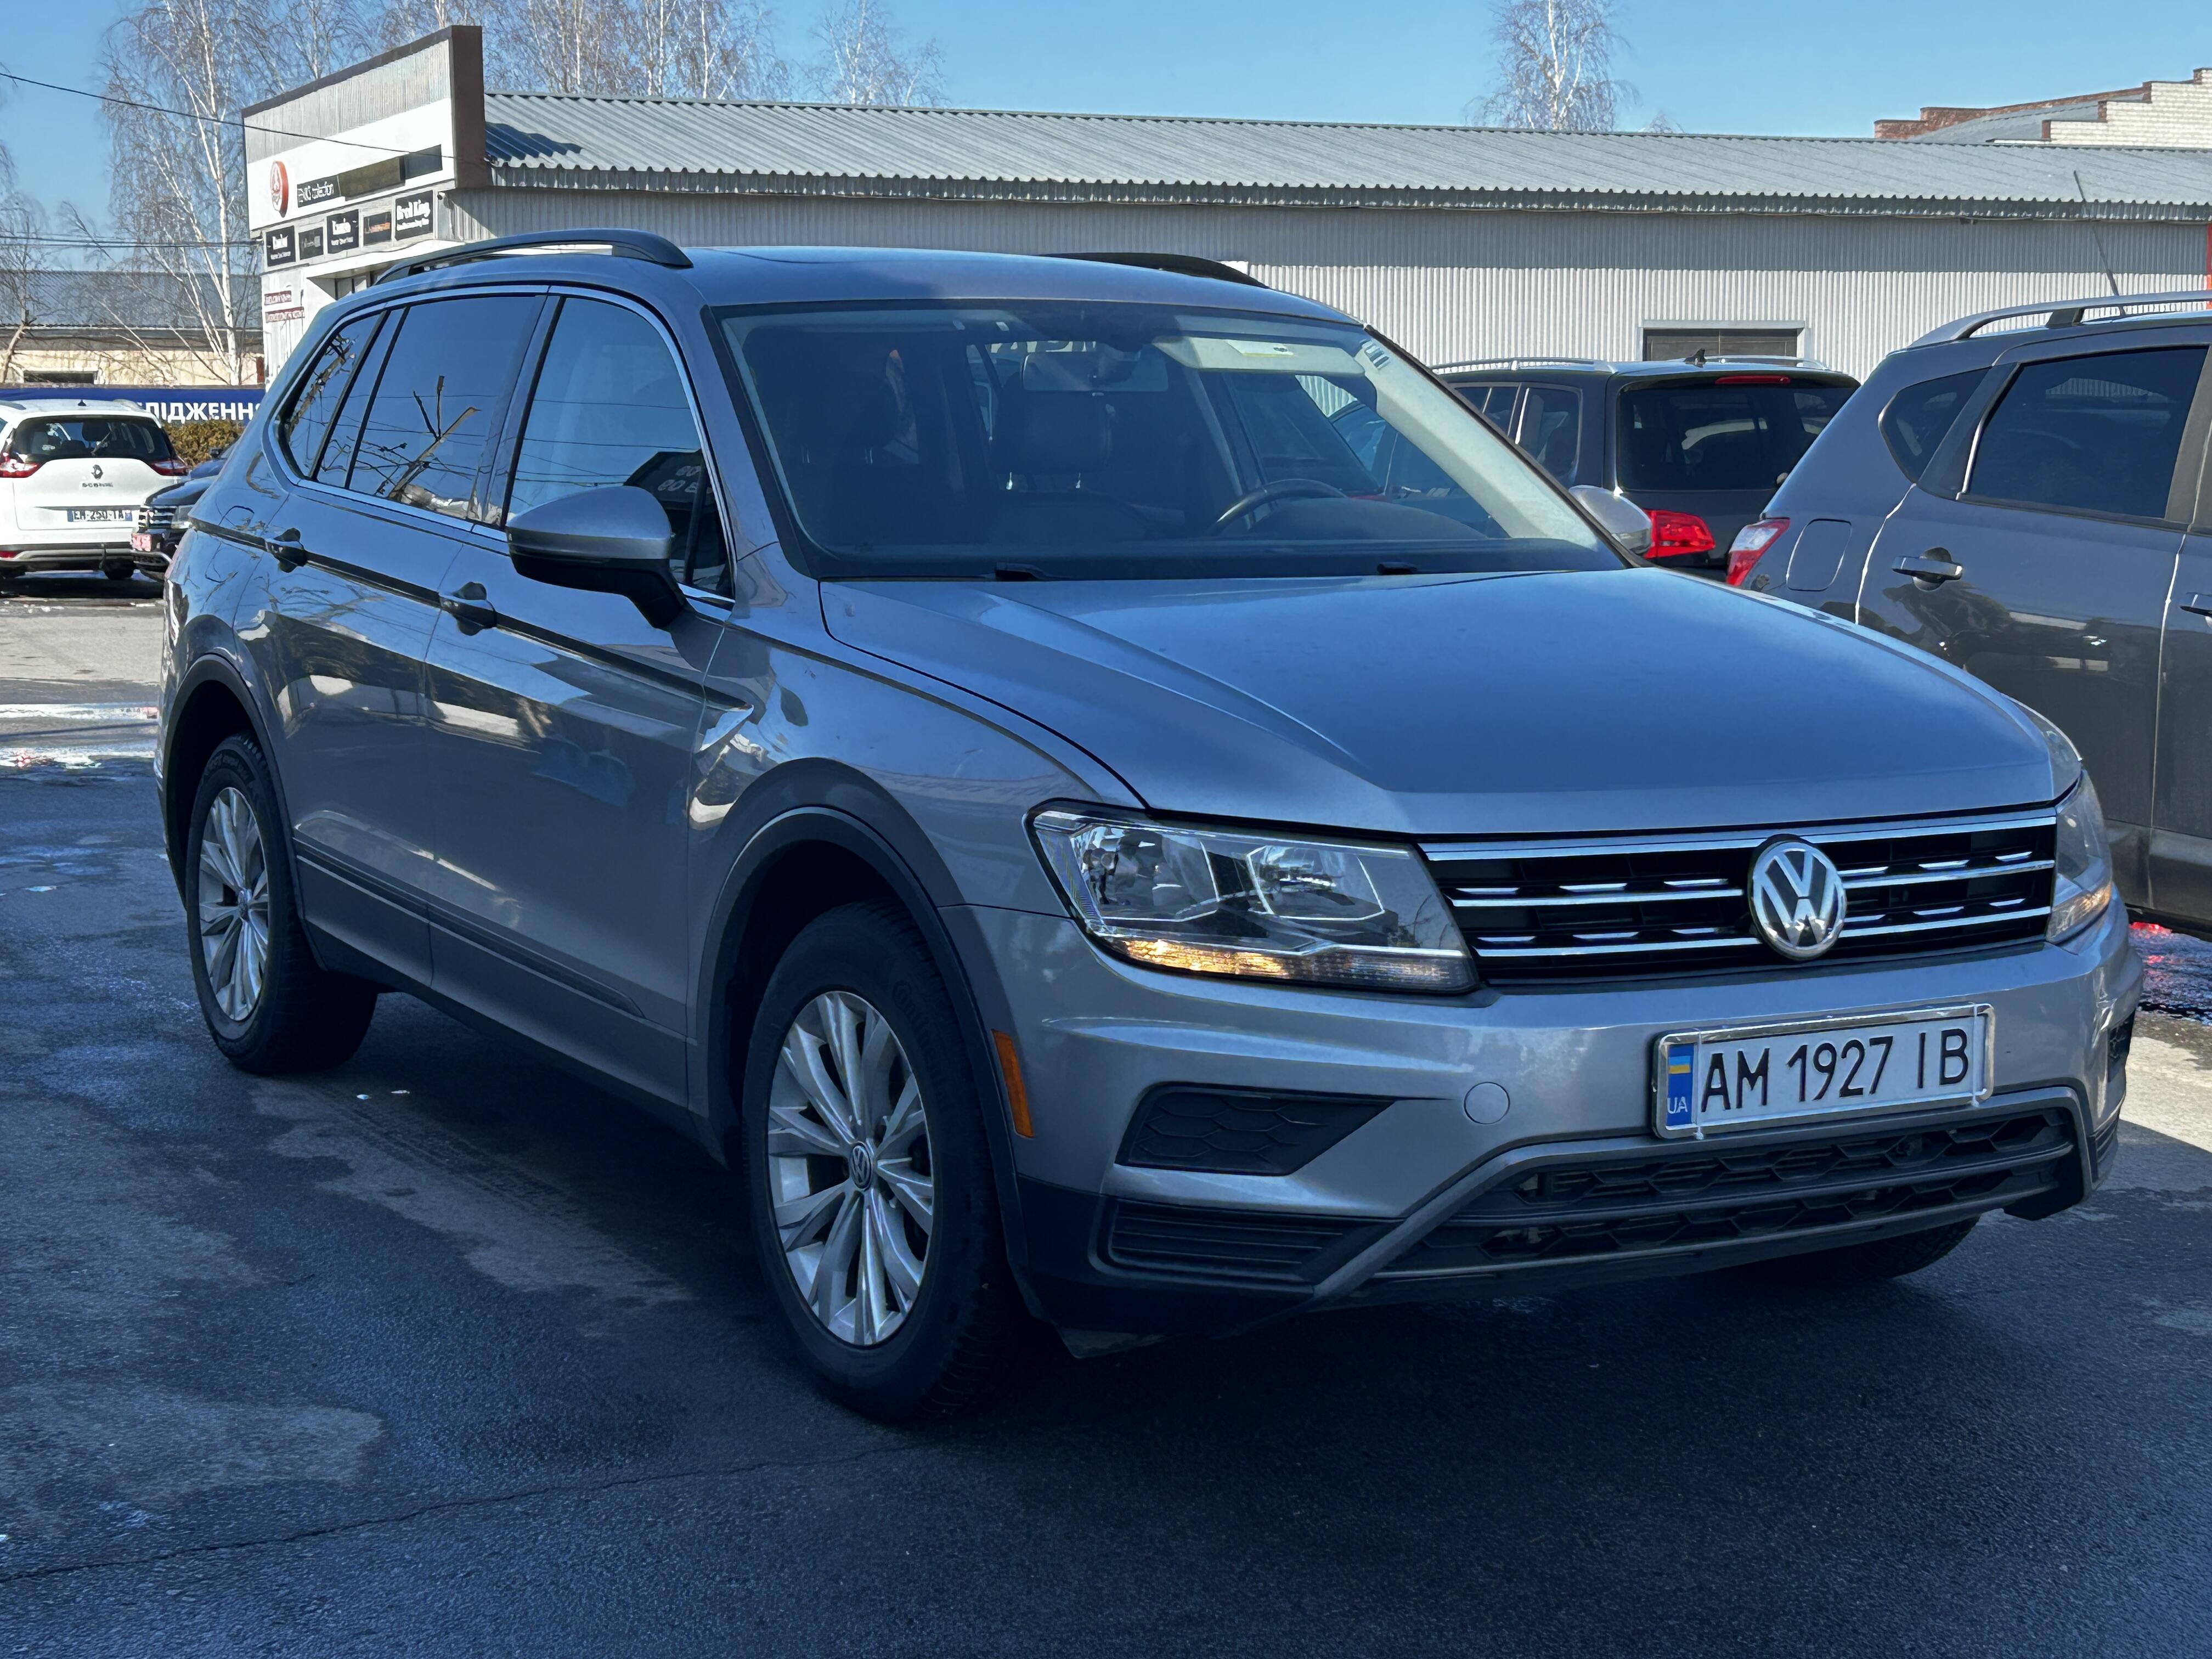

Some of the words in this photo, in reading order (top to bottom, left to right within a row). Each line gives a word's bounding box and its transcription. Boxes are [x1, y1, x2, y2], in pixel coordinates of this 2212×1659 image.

[1701, 1048, 1770, 1113] AM
[1786, 1035, 1893, 1103] 1927
[1919, 1028, 1969, 1089] IB
[1667, 1096, 1688, 1114] UA
